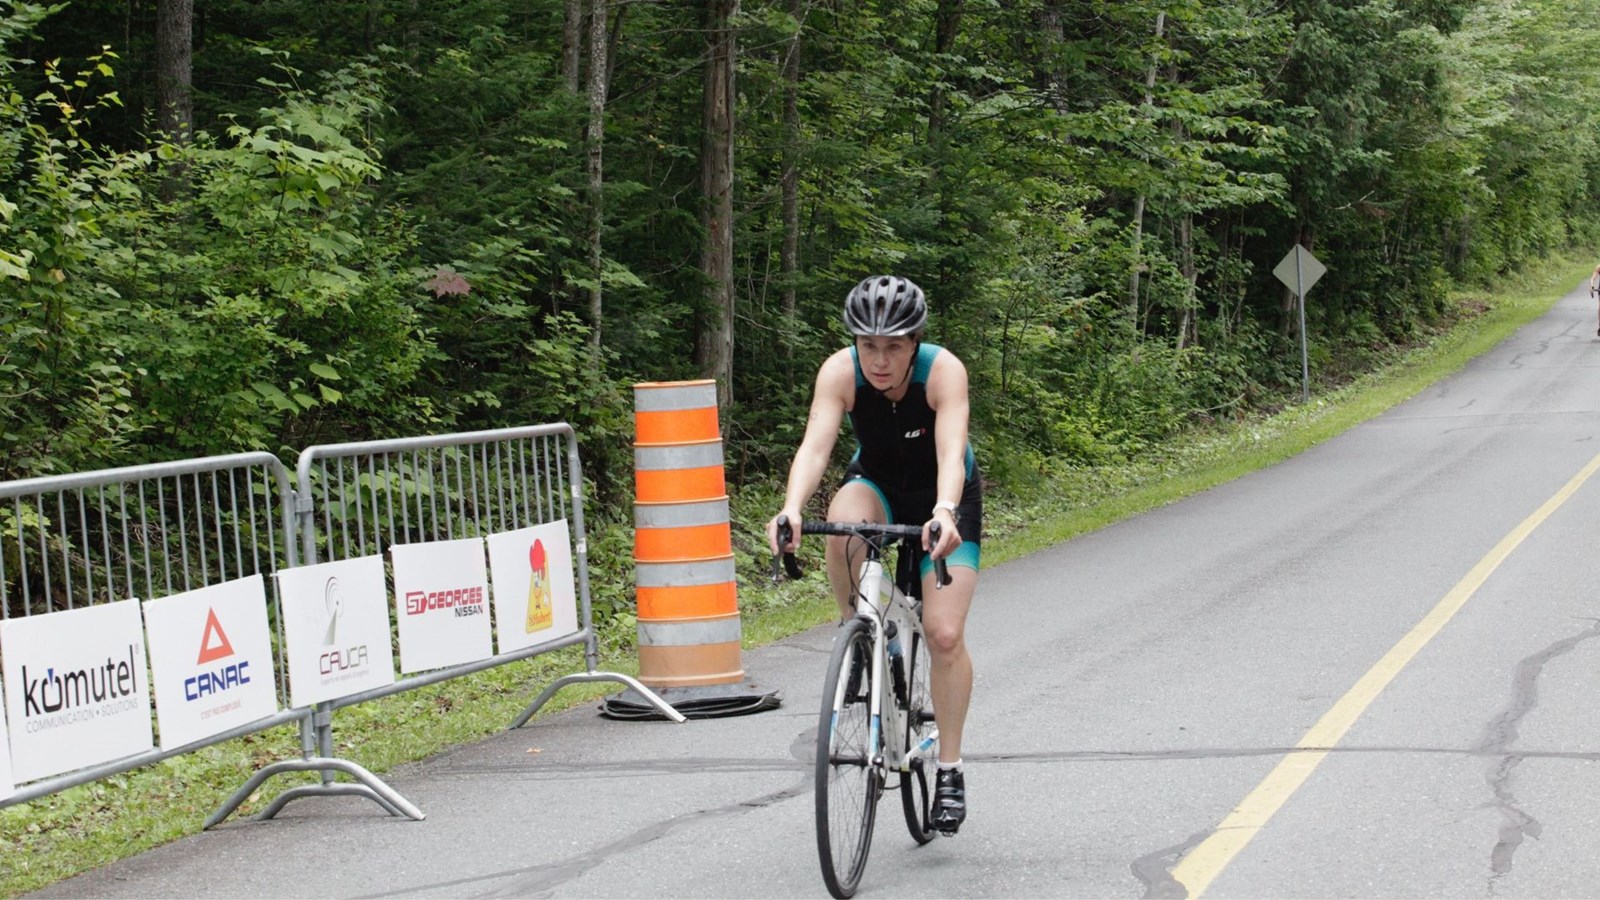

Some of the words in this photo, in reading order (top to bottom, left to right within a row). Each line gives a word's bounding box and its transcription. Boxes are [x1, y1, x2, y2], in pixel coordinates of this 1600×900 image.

[428, 586, 482, 610] GEORGES
[454, 604, 483, 618] NISSAN
[319, 645, 369, 675] CAUCA
[22, 644, 136, 717] komutel
[184, 660, 251, 702] CANAC
[26, 708, 95, 734] COMMUNICATION
[101, 697, 139, 717] SOLUTIONS
